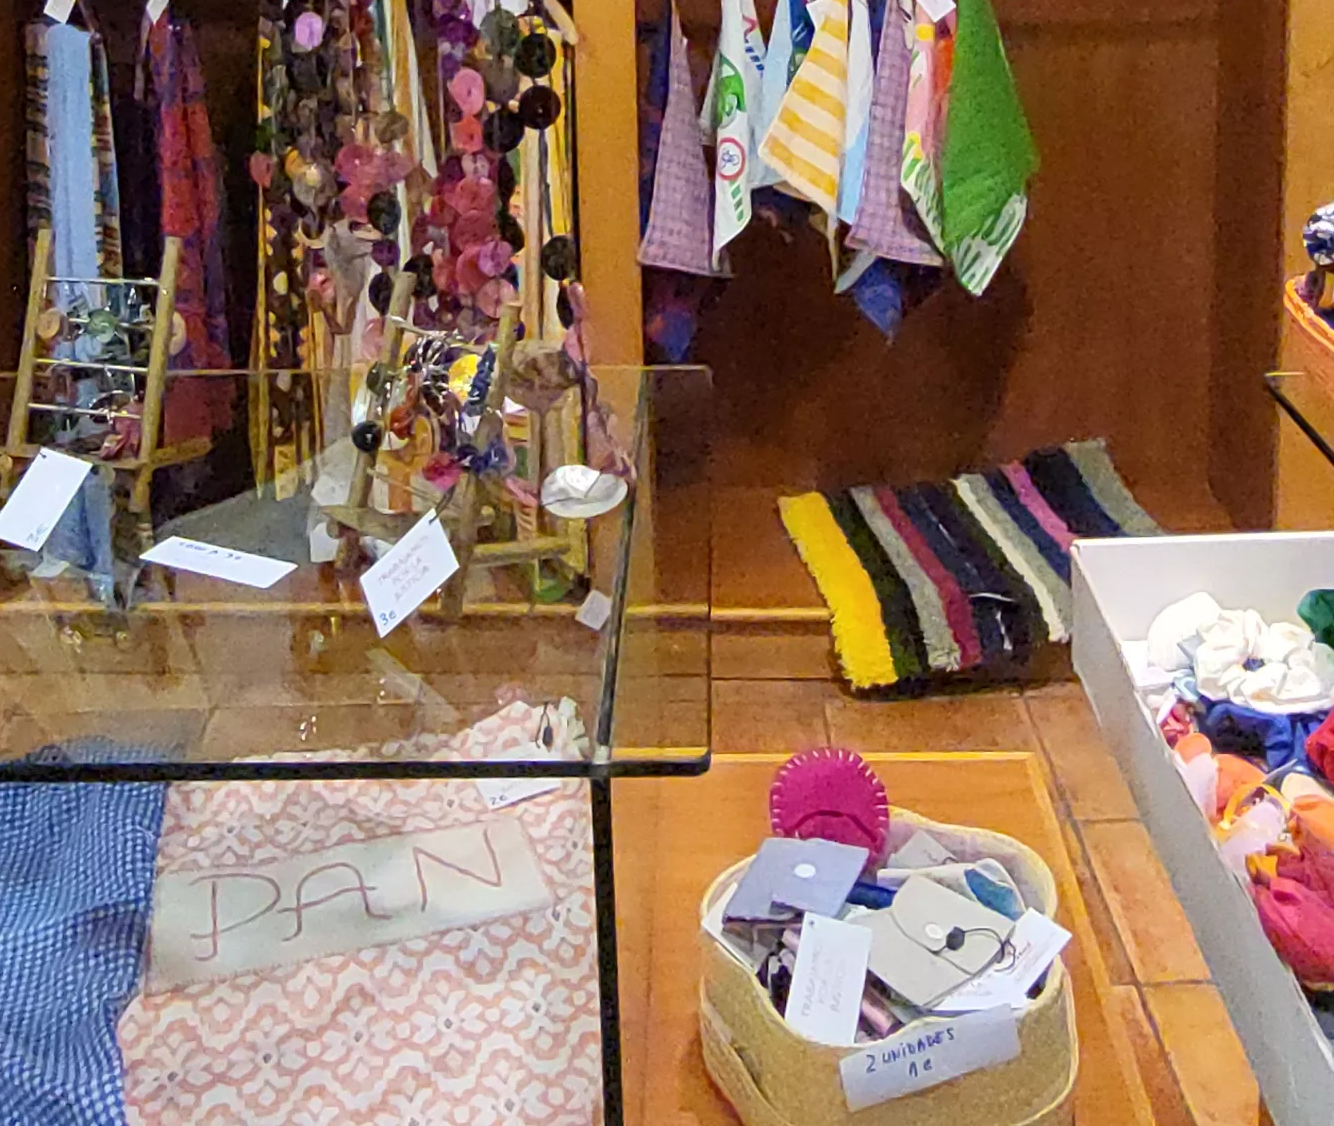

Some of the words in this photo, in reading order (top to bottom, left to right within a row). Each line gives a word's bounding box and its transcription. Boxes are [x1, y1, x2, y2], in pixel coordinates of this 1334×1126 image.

[189, 829, 503, 962] PAN
[866, 1054, 877, 1073] 2
[881, 1027, 955, 1064] UNIDADES
